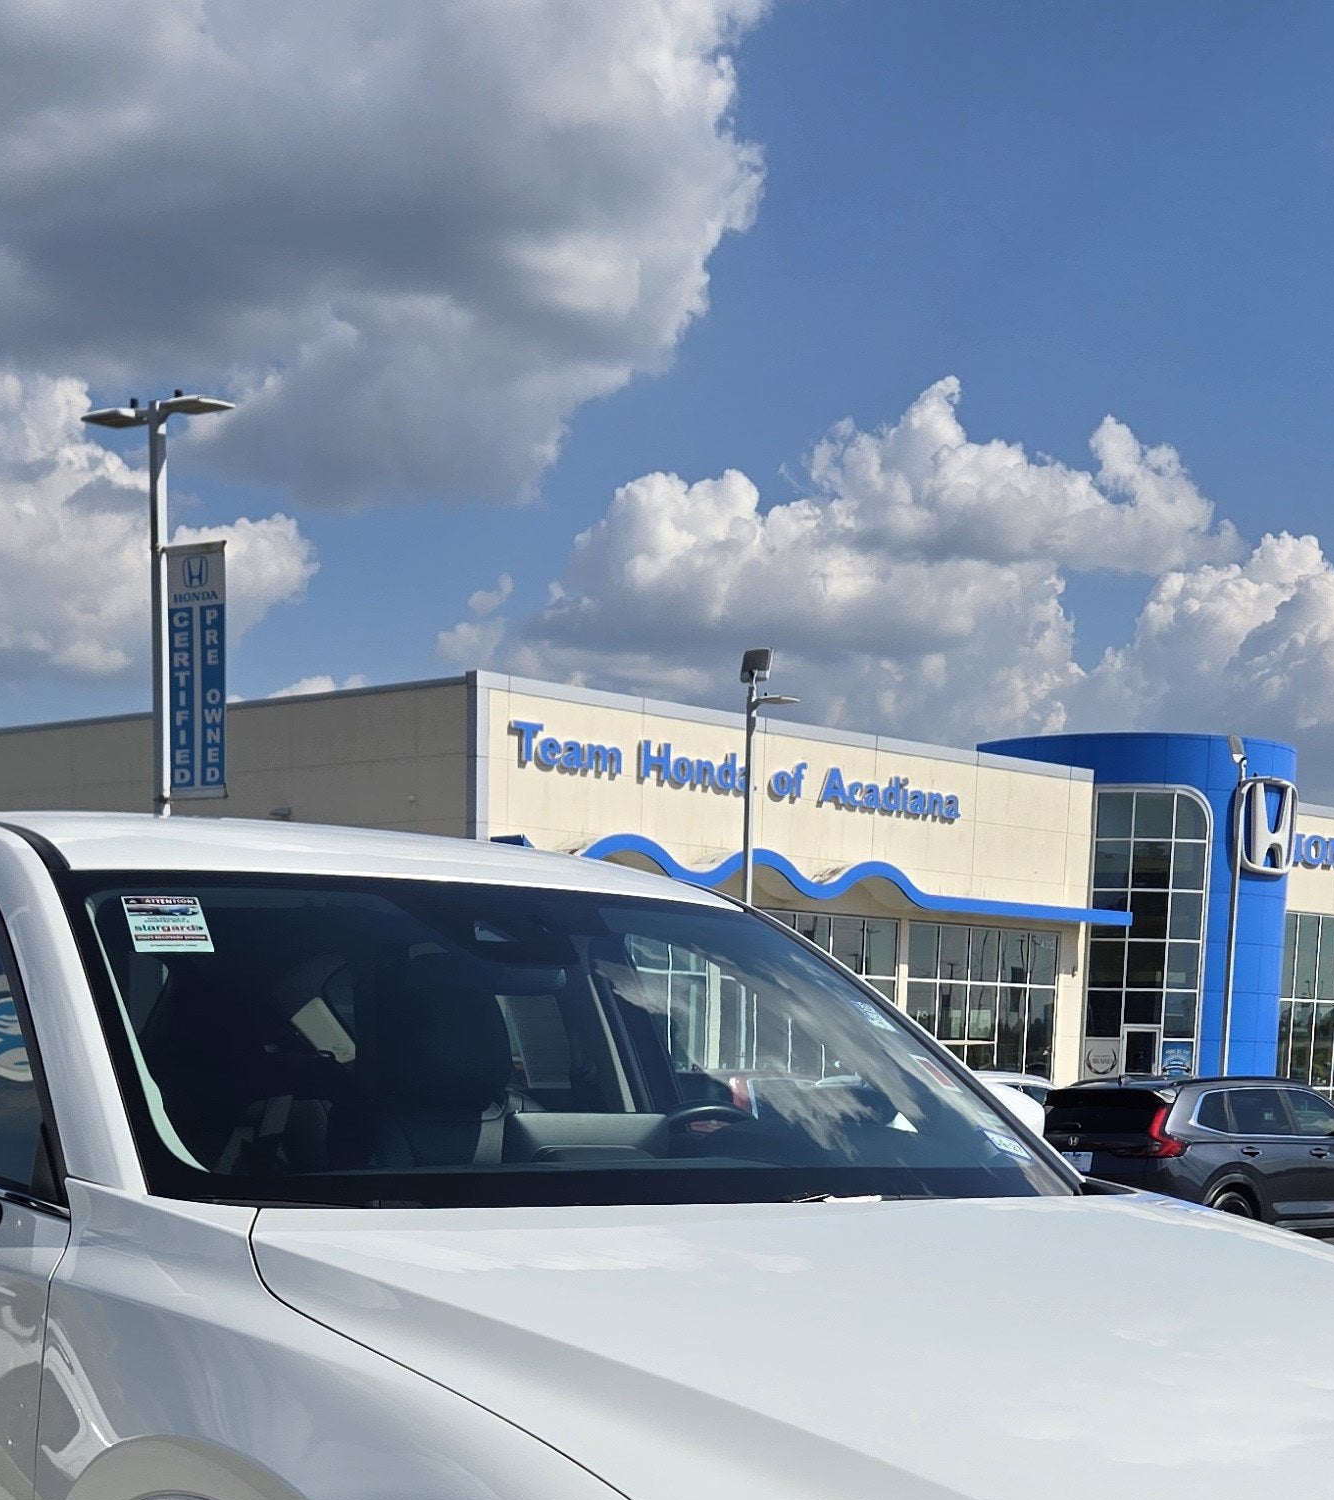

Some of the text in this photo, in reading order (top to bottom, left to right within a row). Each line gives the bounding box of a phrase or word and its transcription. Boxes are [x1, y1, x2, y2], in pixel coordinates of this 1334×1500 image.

[173, 591, 218, 603] HONDA
[173, 611, 192, 785] CERTIFIED
[205, 610, 223, 783] PRE OWNED
[511, 720, 961, 821] Team Honda of Acadiana
